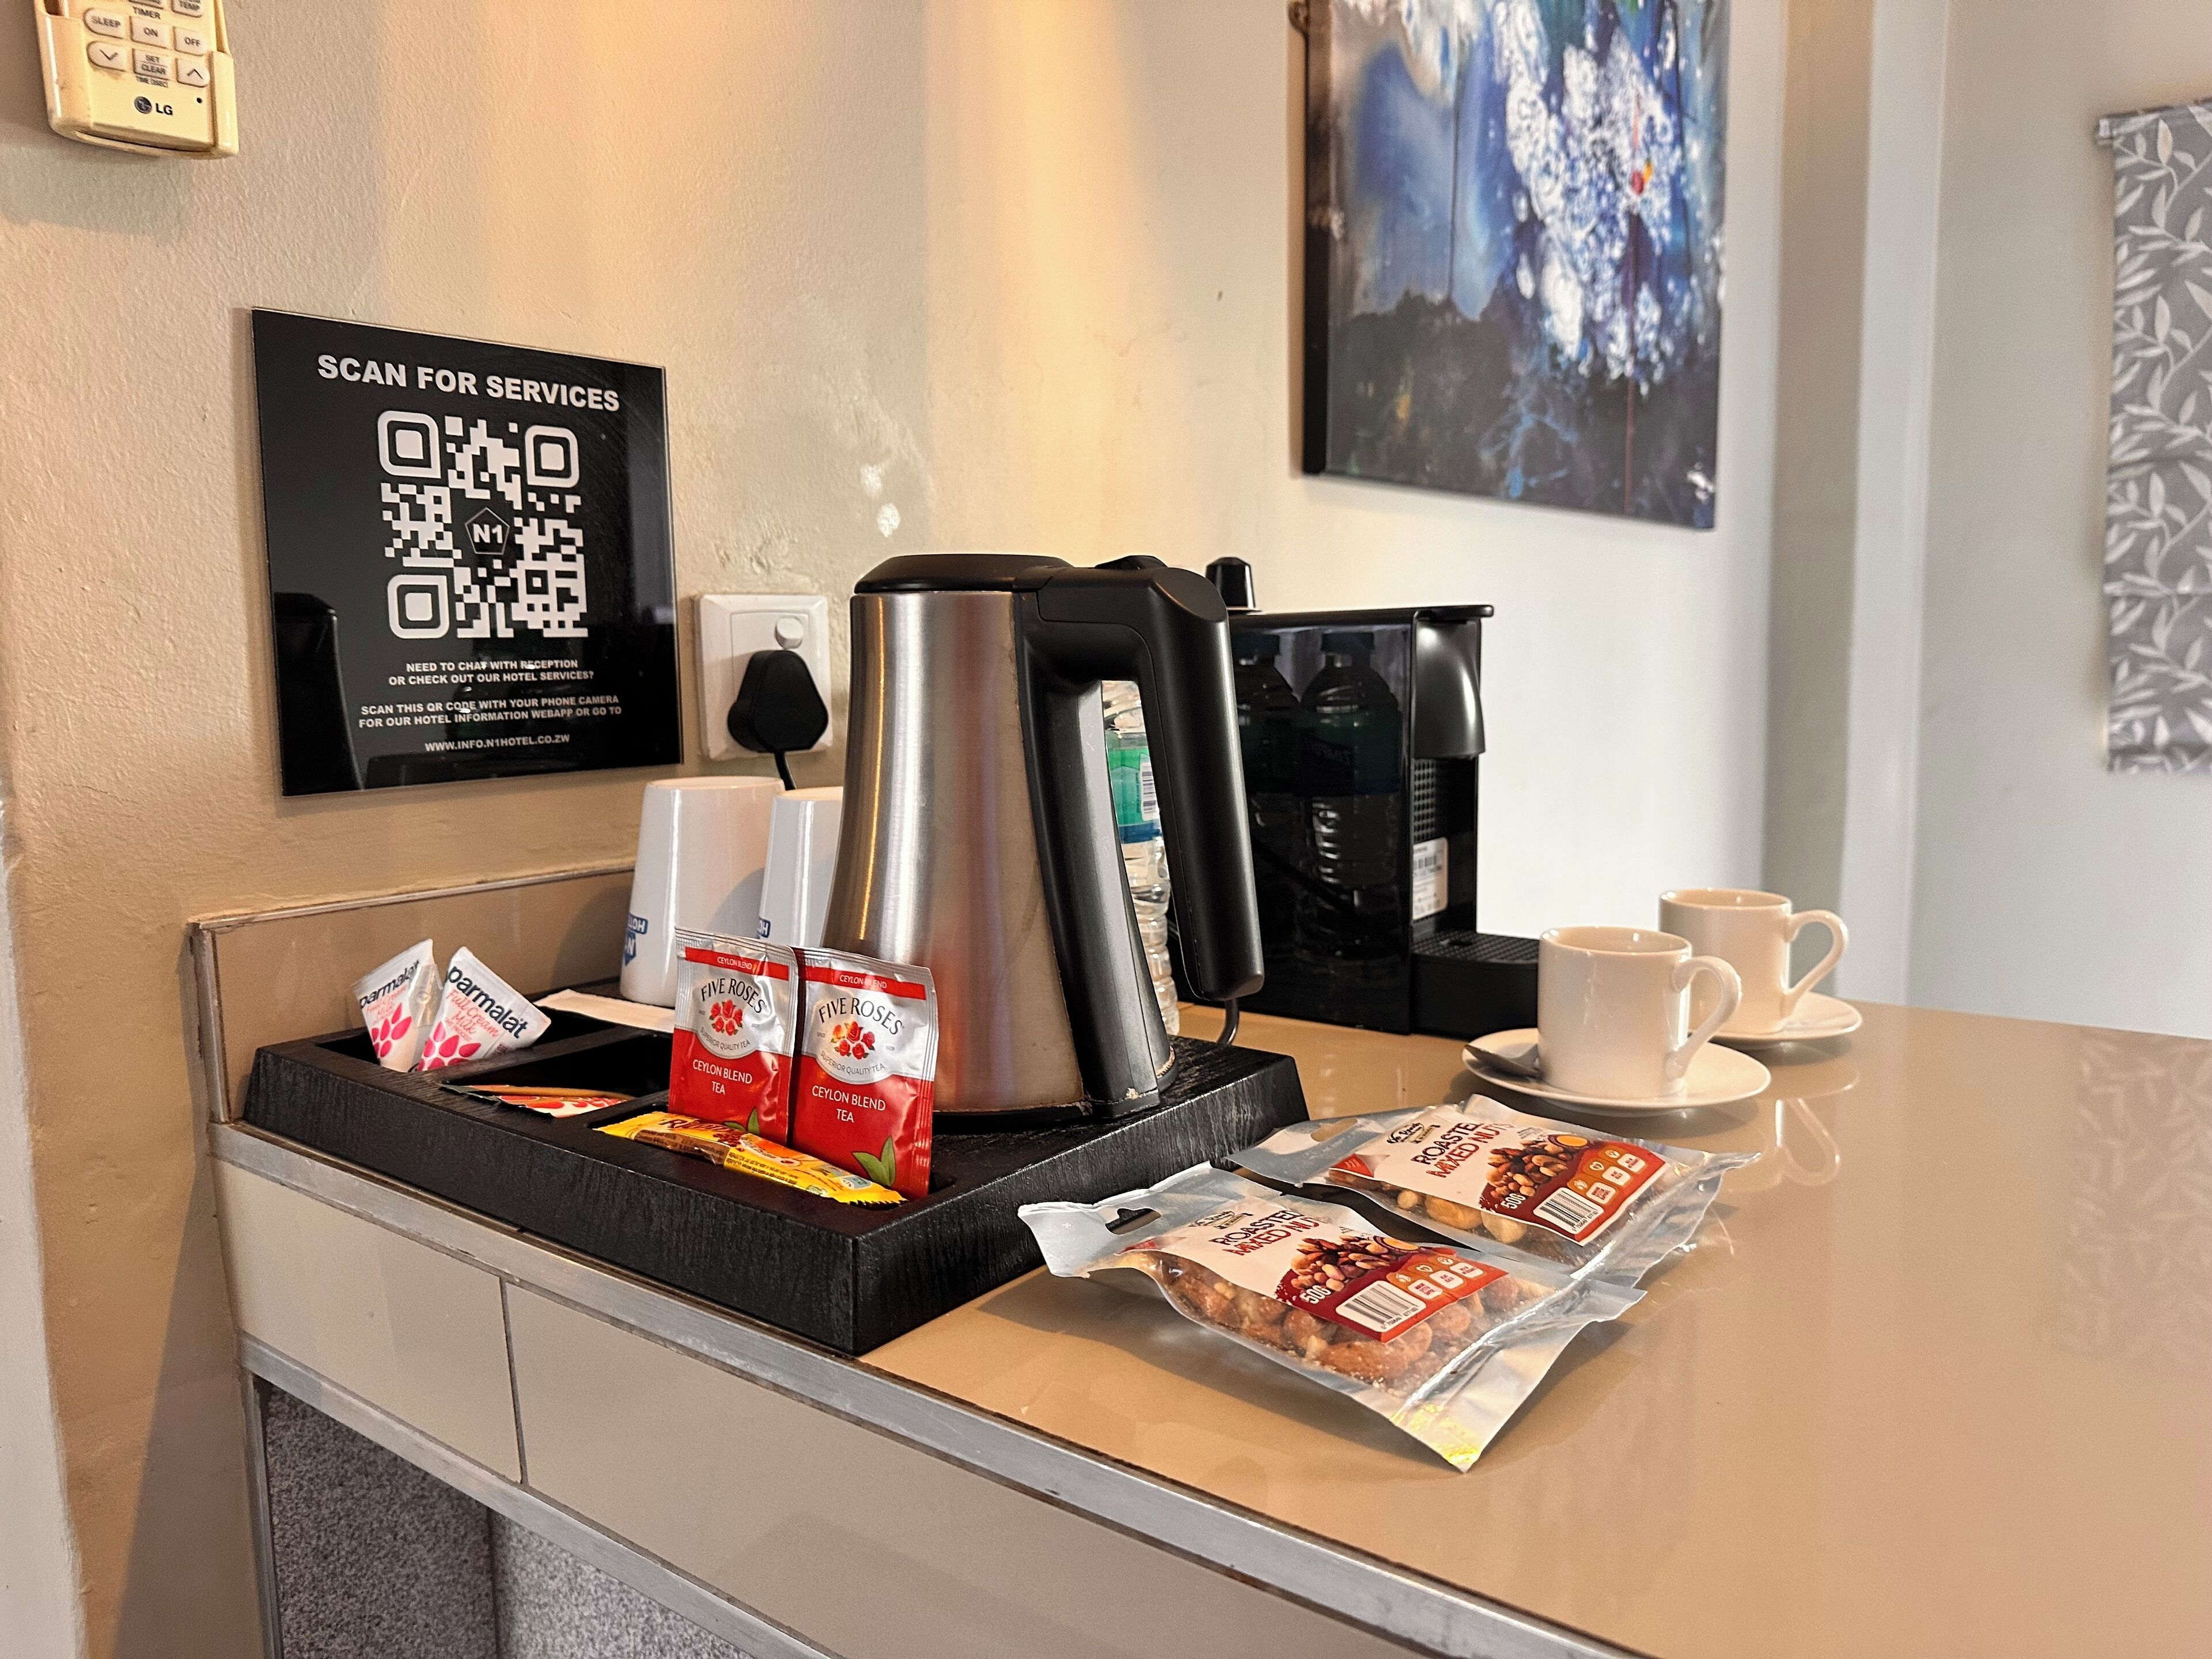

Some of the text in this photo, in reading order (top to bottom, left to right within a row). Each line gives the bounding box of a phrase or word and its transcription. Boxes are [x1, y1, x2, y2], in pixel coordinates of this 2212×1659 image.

[91, 16, 121, 28] SLEEP
[132, 6, 161, 20] TIMER
[144, 27, 158, 37] ON
[184, 37, 200, 47] OFF
[145, 55, 160, 63] SET
[142, 63, 166, 75] CLEAR
[156, 103, 173, 115] LG
[318, 355, 620, 411] SCAN FOR SERVICES
[473, 524, 503, 543] N1
[406, 659, 578, 672] NEED TO CHAT WITH RECEPTION
[388, 671, 594, 685] OR CHECK OUT OUR HOTEL SERVICES?
[361, 695, 619, 715] SCAN THIS QR CODE WITH YOUR PHONE CAMERA
[359, 706, 622, 728] FOR OUR HOTEL INFORMATION WEBAPP OR GO TO
[425, 734, 570, 752] WWW.INFO.N1HOTEL.CO.ZW
[717, 956, 753, 970] CEYLON BLEND
[839, 975, 887, 988] CEYLON END
[447, 966, 529, 1039] parmalat
[701, 978, 765, 1013] FIVE ROSES
[446, 989, 472, 1010] Full
[467, 1007, 499, 1037] Cream
[451, 1011, 477, 1034] Milk
[819, 997, 903, 1036] FIVE ROSES
[700, 1027, 751, 1051] SUPERIOR QUALITY TEA
[692, 1059, 752, 1084] CEYLON BLEND
[820, 1050, 885, 1075] SUPERIOR QUALITY TEA
[711, 1081, 725, 1094] TEA
[812, 1085, 886, 1111] CEYLON BLEND
[836, 1108, 855, 1123] TEA
[1426, 1143, 1480, 1178] MIXED
[1501, 1192, 1526, 1209] 50G
[1209, 1210, 1305, 1245] ROASTED
[1222, 1229, 1291, 1256] MIXED
[1301, 1285, 1331, 1304] 50G
